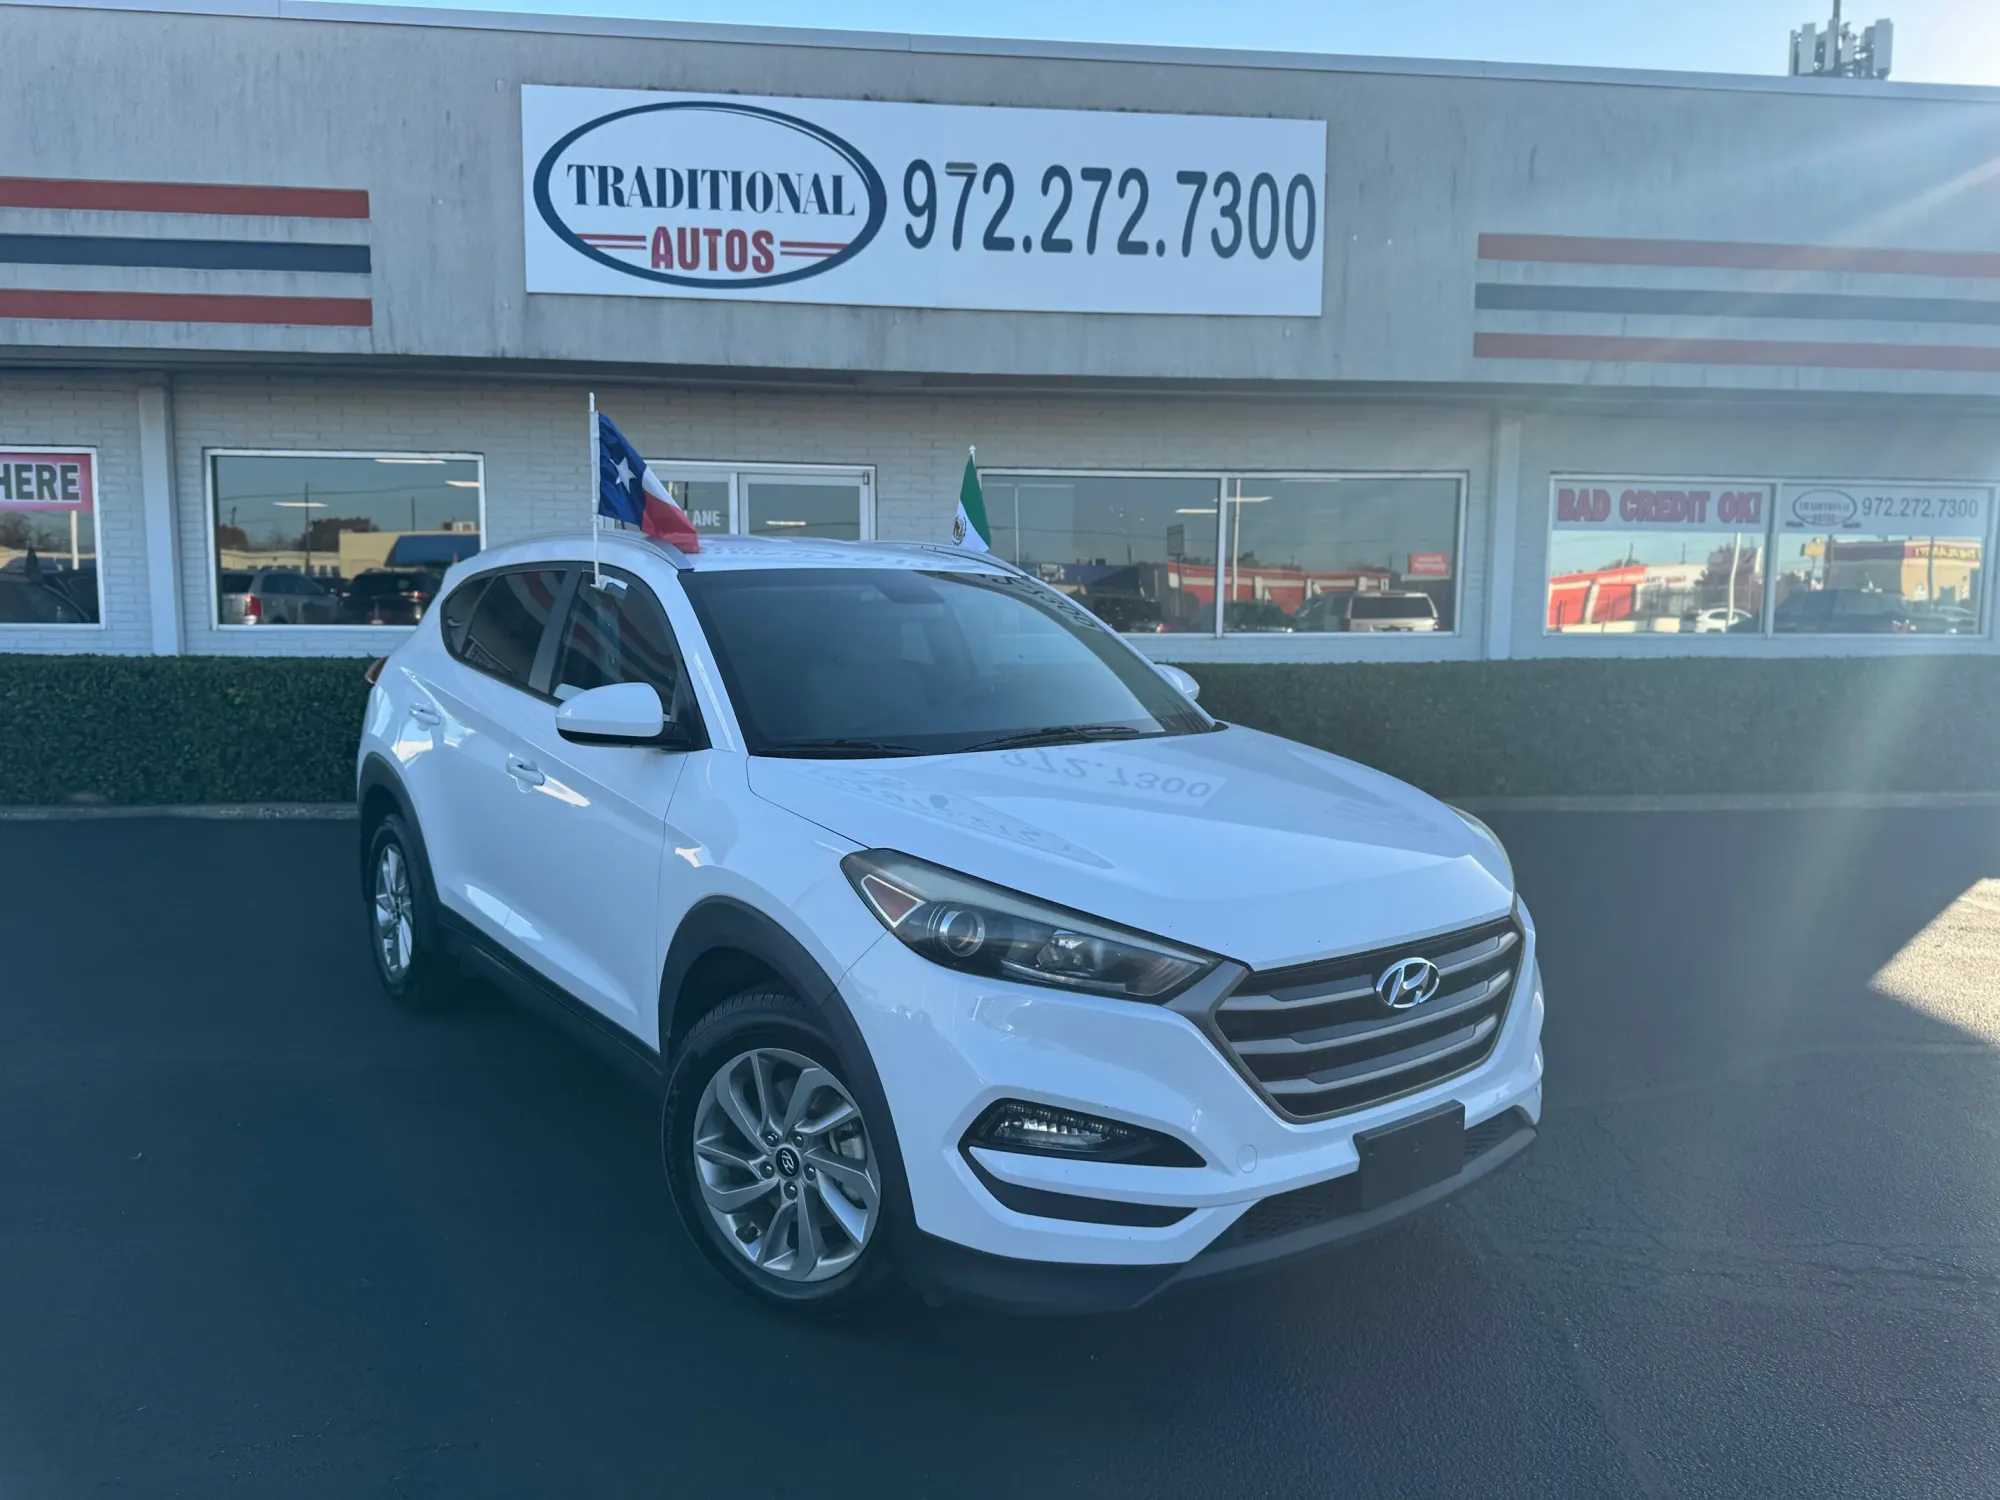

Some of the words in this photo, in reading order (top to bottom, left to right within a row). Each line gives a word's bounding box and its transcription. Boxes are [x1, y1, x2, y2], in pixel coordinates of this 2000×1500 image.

[567, 163, 855, 218] TRADITIONAL
[903, 158, 1316, 261] 972.272.7300
[651, 226, 775, 274] AUTOS
[0, 463, 81, 501] HERE
[684, 509, 721, 527] ANE
[1558, 488, 1611, 522] BAD
[1619, 489, 1711, 523] CREDIT
[1717, 491, 1763, 524] OK!
[1862, 497, 1979, 518] 972.272.7300
